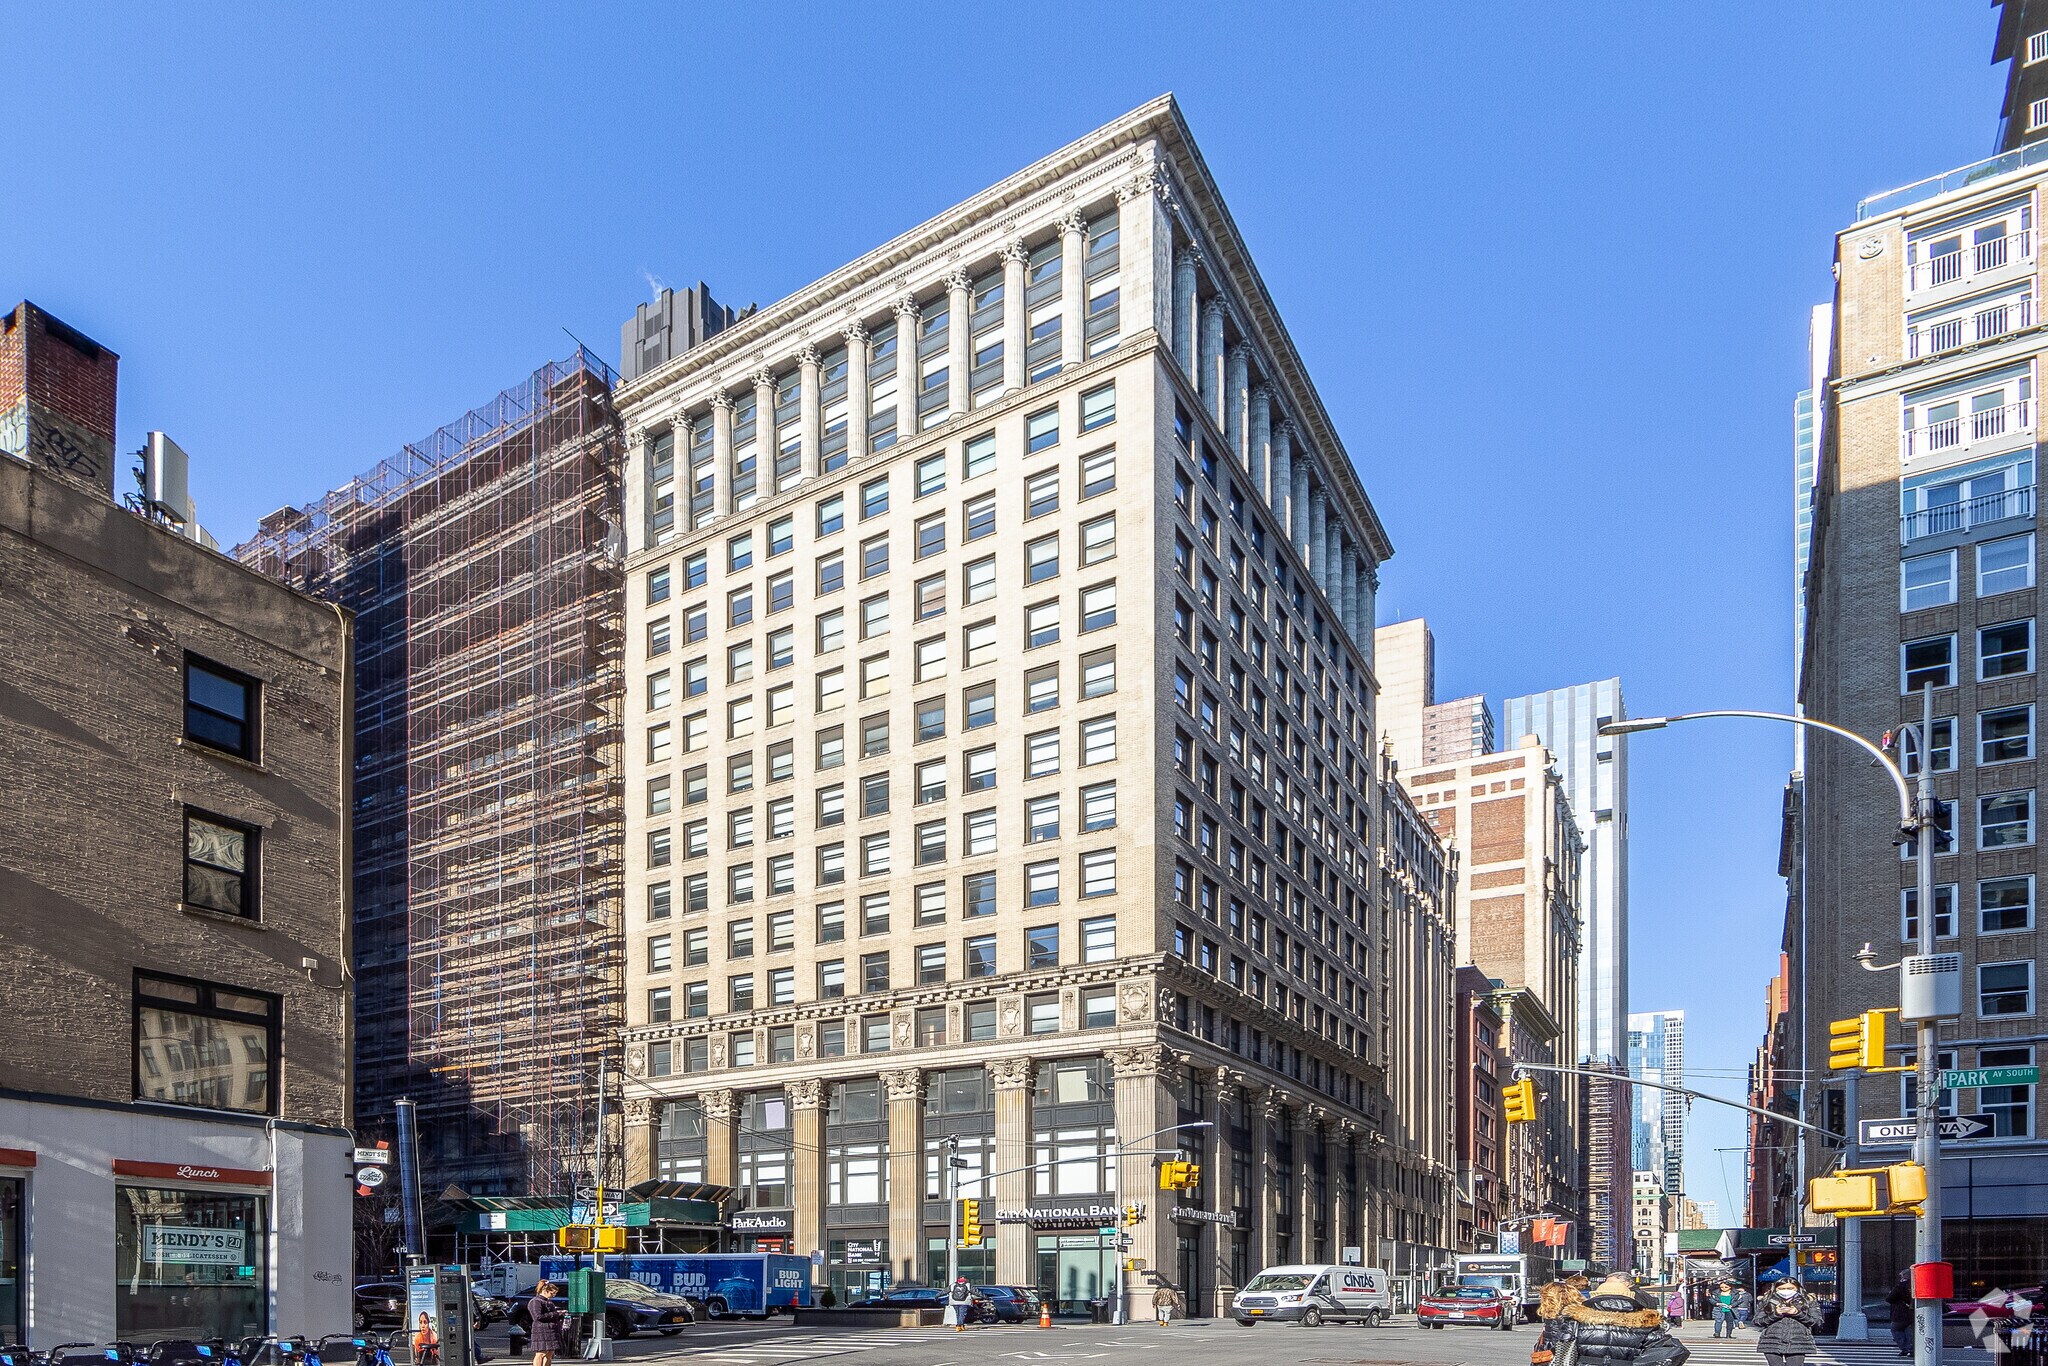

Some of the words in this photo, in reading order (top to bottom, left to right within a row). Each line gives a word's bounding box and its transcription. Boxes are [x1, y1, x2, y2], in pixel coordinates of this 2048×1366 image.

[1950, 1071, 1989, 1087] PARK
[1992, 1070, 2003, 1078] AV
[2006, 1069, 2034, 1077] SOUTH
[1880, 1126, 1916, 1137] ONE
[176, 1165, 220, 1179] Lunch
[1024, 1207, 1089, 1218] NATIONAL
[151, 1232, 225, 1248] MENDY'S
[629, 1272, 661, 1285] BUD
[673, 1273, 706, 1286] BUD
[779, 1270, 800, 1280] BUD
[1343, 1271, 1375, 1288] CINTAS
[775, 1279, 803, 1289] LIGHT
